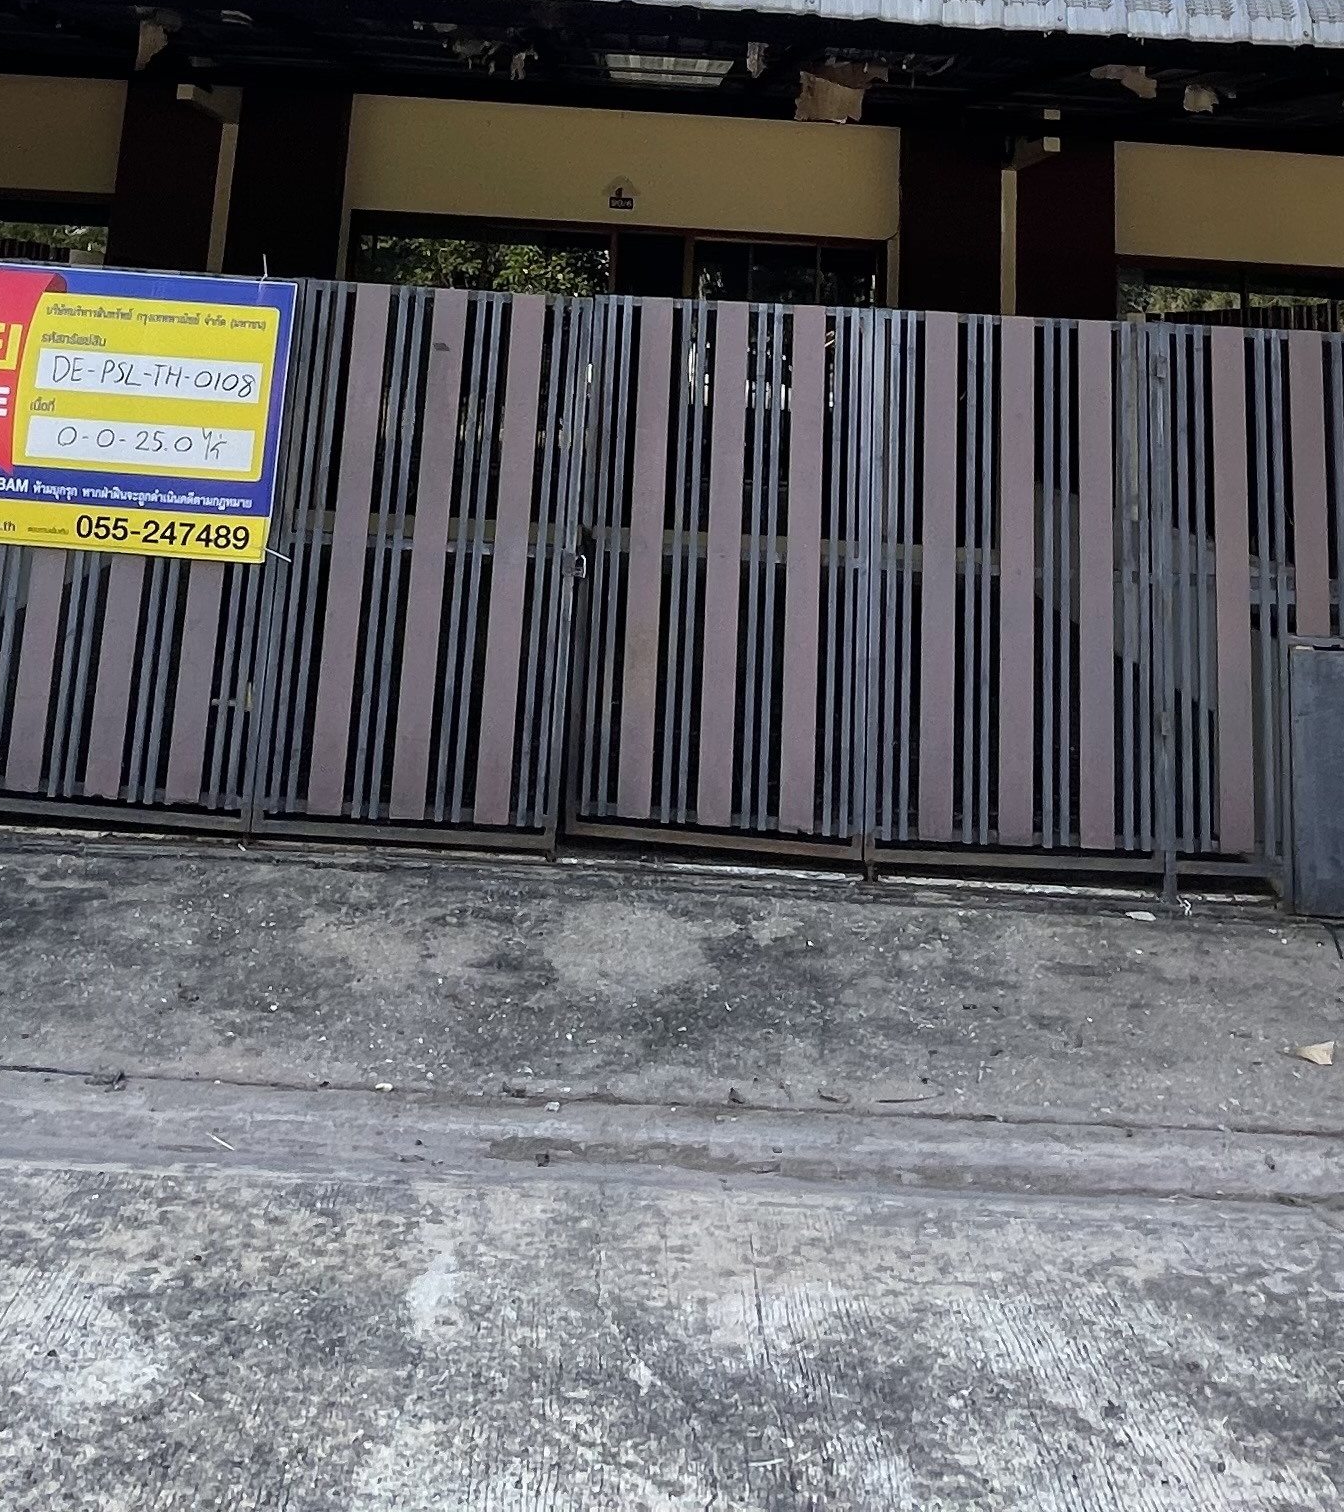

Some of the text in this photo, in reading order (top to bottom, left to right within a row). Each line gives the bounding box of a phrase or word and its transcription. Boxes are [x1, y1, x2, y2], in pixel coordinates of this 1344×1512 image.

[32, 480, 78, 501] ห้ามบุกรุก
[76, 514, 250, 550] 055-247489
